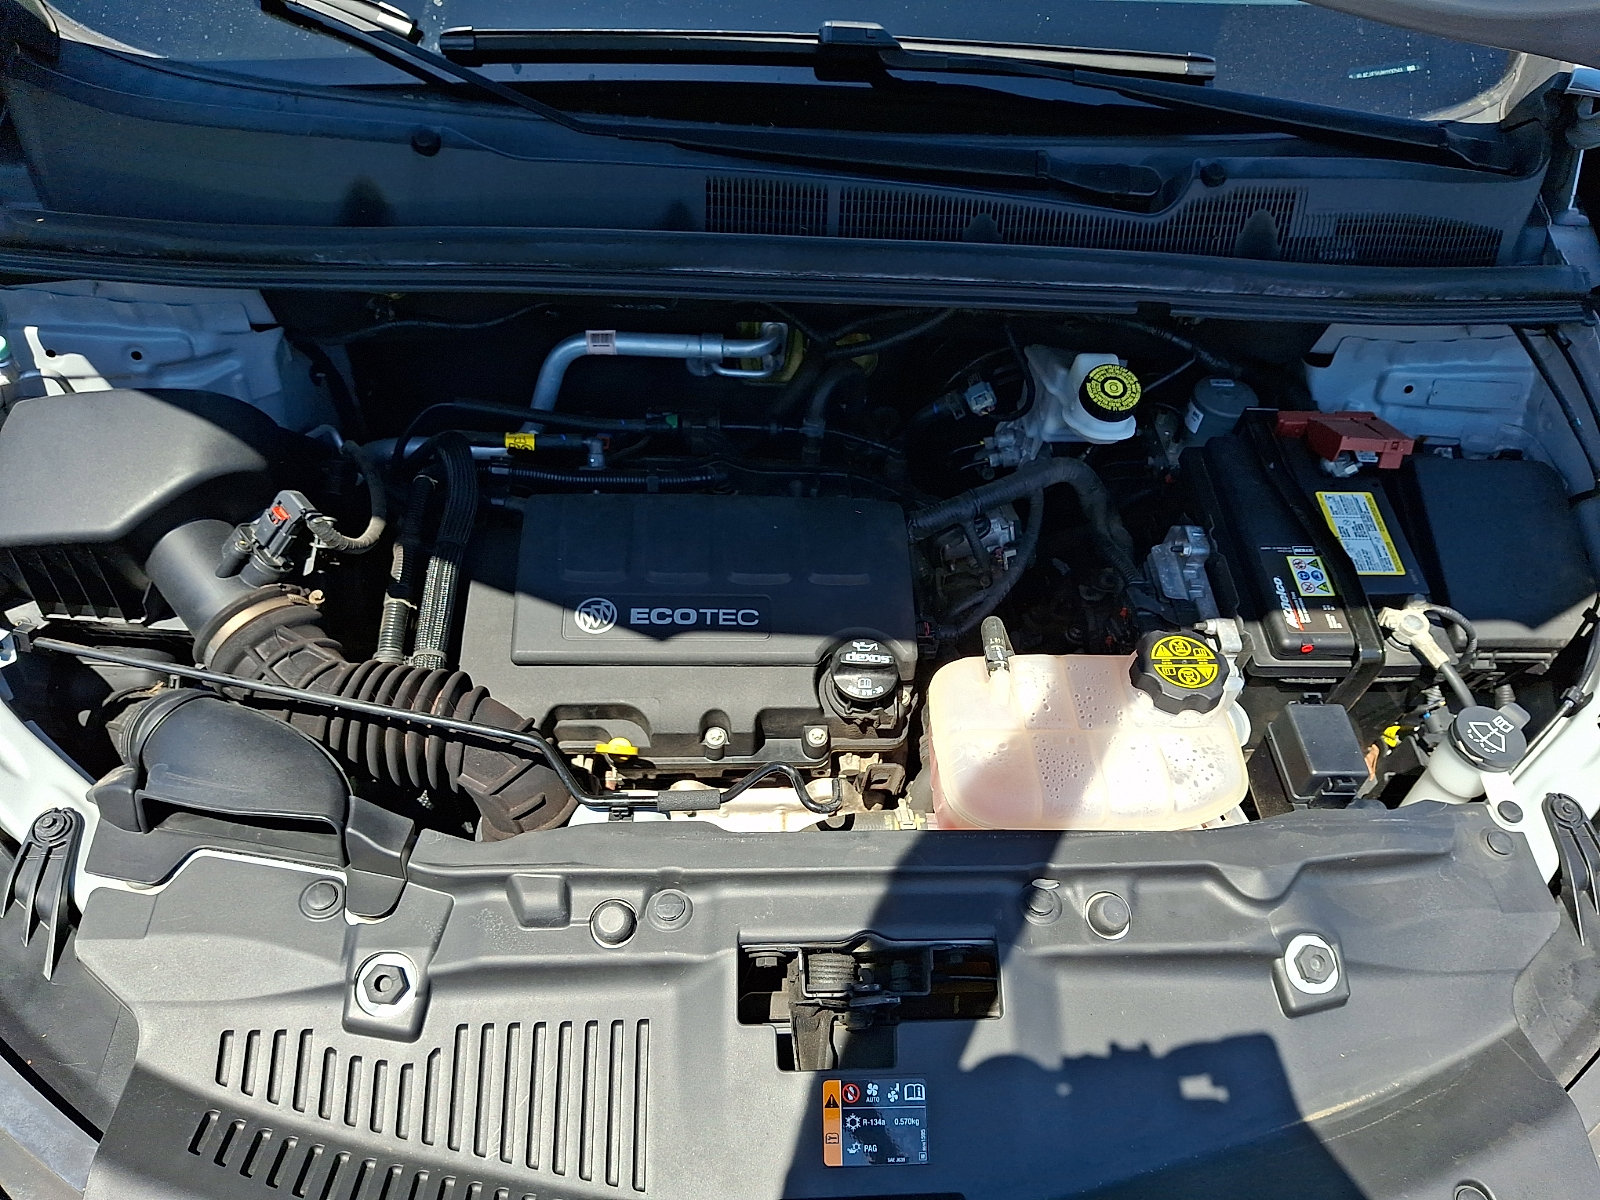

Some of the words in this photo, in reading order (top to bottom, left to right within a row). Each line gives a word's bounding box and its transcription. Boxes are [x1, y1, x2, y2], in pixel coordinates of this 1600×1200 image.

[630, 607, 760, 626] ECOTEC
[862, 1118, 886, 1126] R-134a
[894, 1117, 920, 1127] 0.570kg
[863, 1144, 878, 1153] PAG
